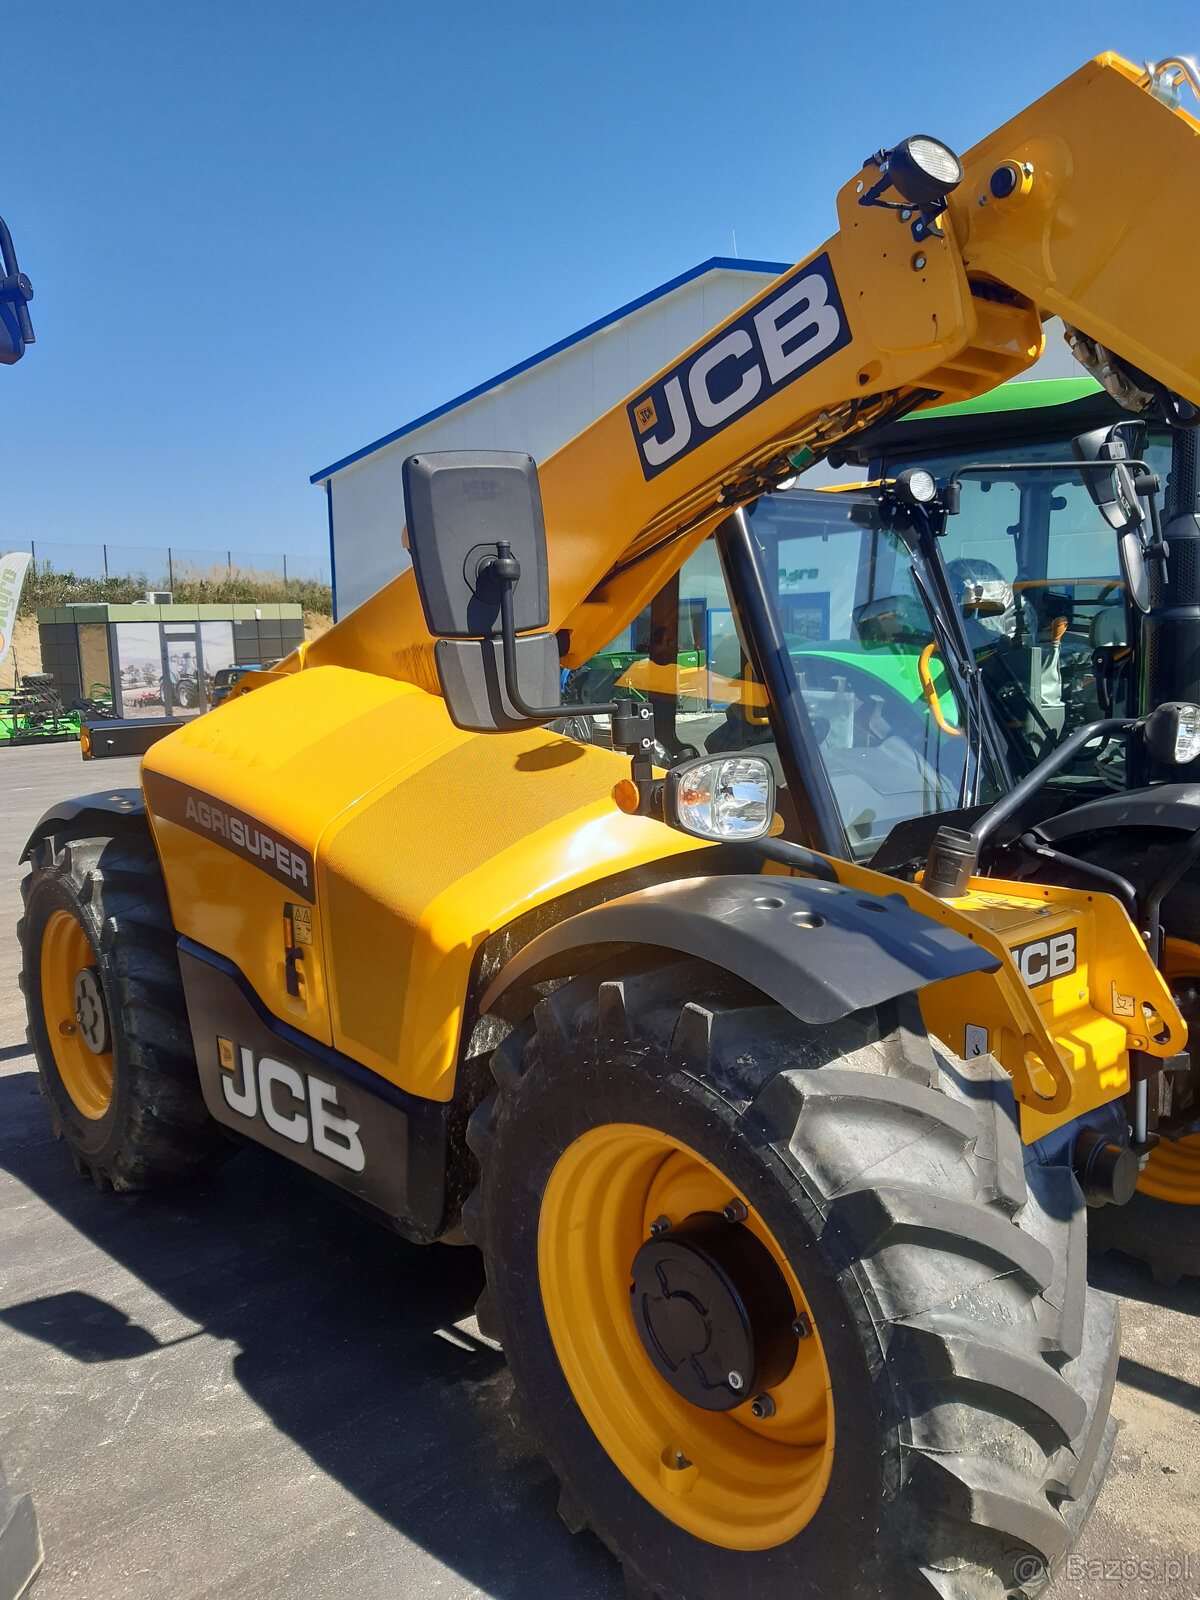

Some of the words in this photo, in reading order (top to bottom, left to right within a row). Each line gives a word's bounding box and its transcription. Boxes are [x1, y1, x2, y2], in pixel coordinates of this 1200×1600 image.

[642, 274, 840, 466] JCB
[185, 796, 308, 888] AGRISUPER
[222, 1047, 366, 1172] JCB
